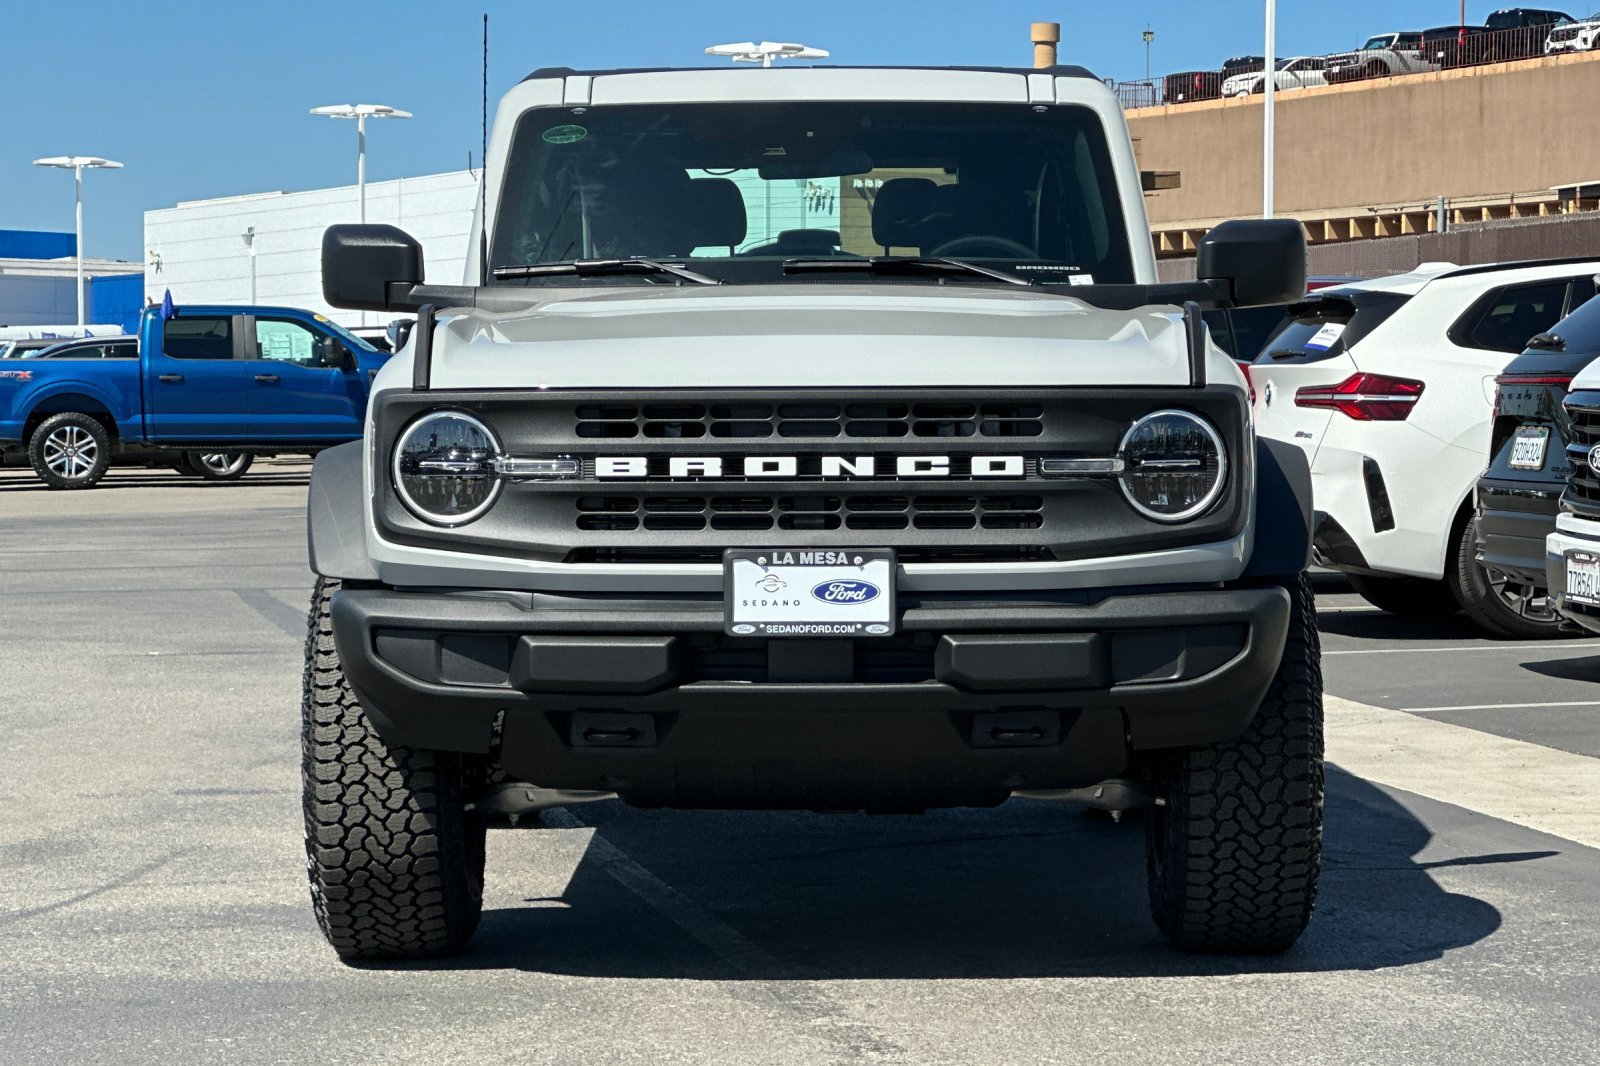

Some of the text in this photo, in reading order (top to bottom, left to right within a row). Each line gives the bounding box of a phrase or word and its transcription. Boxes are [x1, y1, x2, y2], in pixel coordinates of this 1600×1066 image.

[595, 456, 1024, 477] BRONCO
[773, 552, 848, 564] LA MESA
[825, 583, 867, 601] Ford
[766, 624, 855, 634] SEDANOFORD.COM
